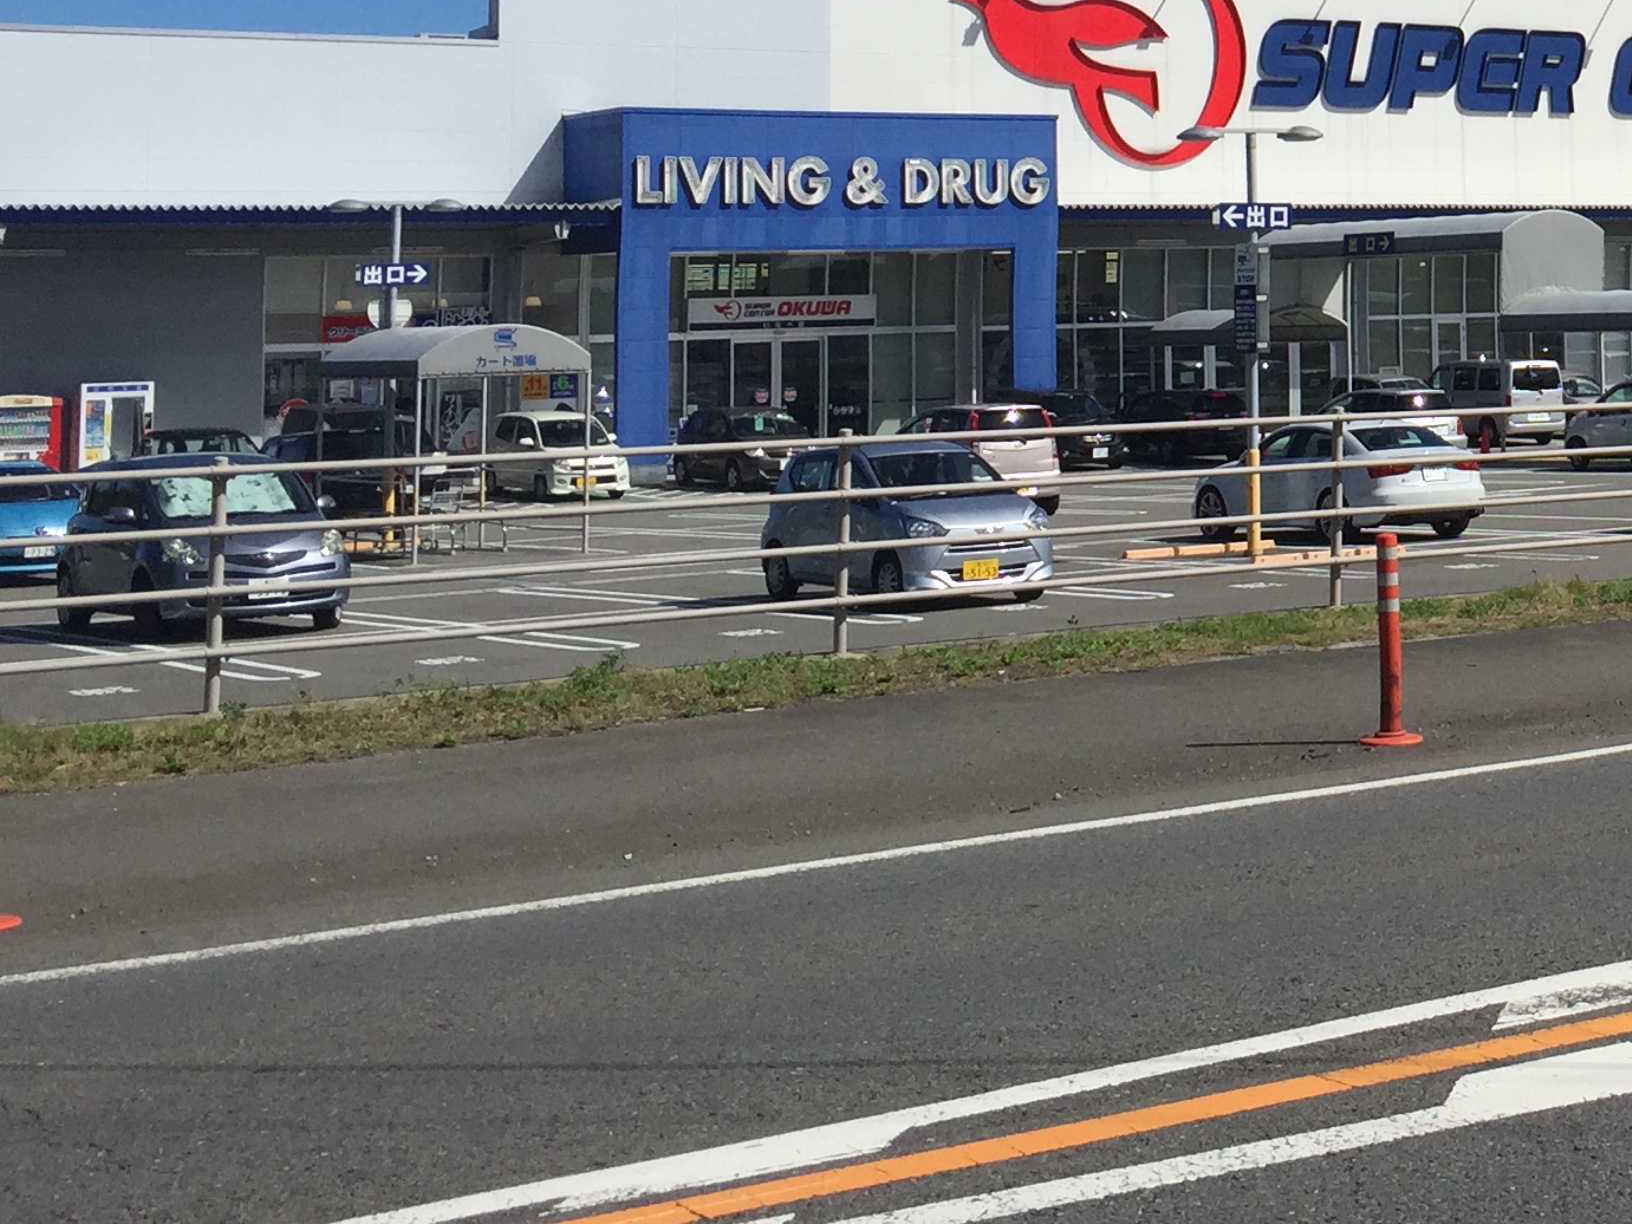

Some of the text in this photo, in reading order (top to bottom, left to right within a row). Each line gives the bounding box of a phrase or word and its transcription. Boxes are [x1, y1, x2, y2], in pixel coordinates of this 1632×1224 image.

[1250, 19, 1586, 114] SUPER
[634, 155, 1050, 206] LIVING & DRUG
[1246, 206, 1289, 228] 出口
[363, 265, 405, 285] 出口
[777, 300, 852, 317] OKUWA
